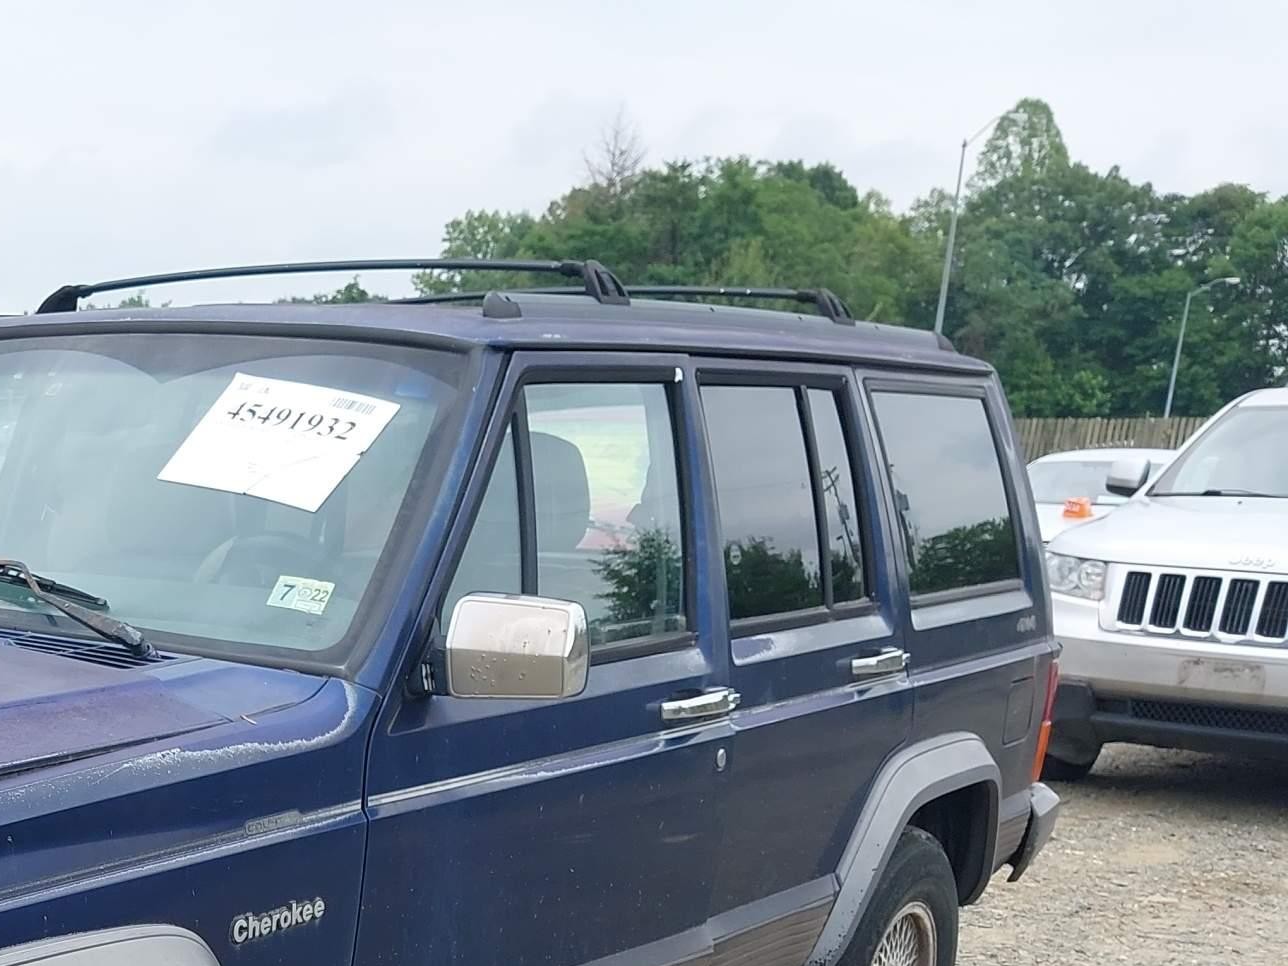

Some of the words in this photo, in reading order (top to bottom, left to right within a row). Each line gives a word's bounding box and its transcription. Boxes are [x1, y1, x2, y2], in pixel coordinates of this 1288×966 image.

[227, 401, 357, 441] 45491932
[279, 584, 296, 601] 7
[310, 588, 329, 603] 22
[232, 899, 326, 943] Cherokee
